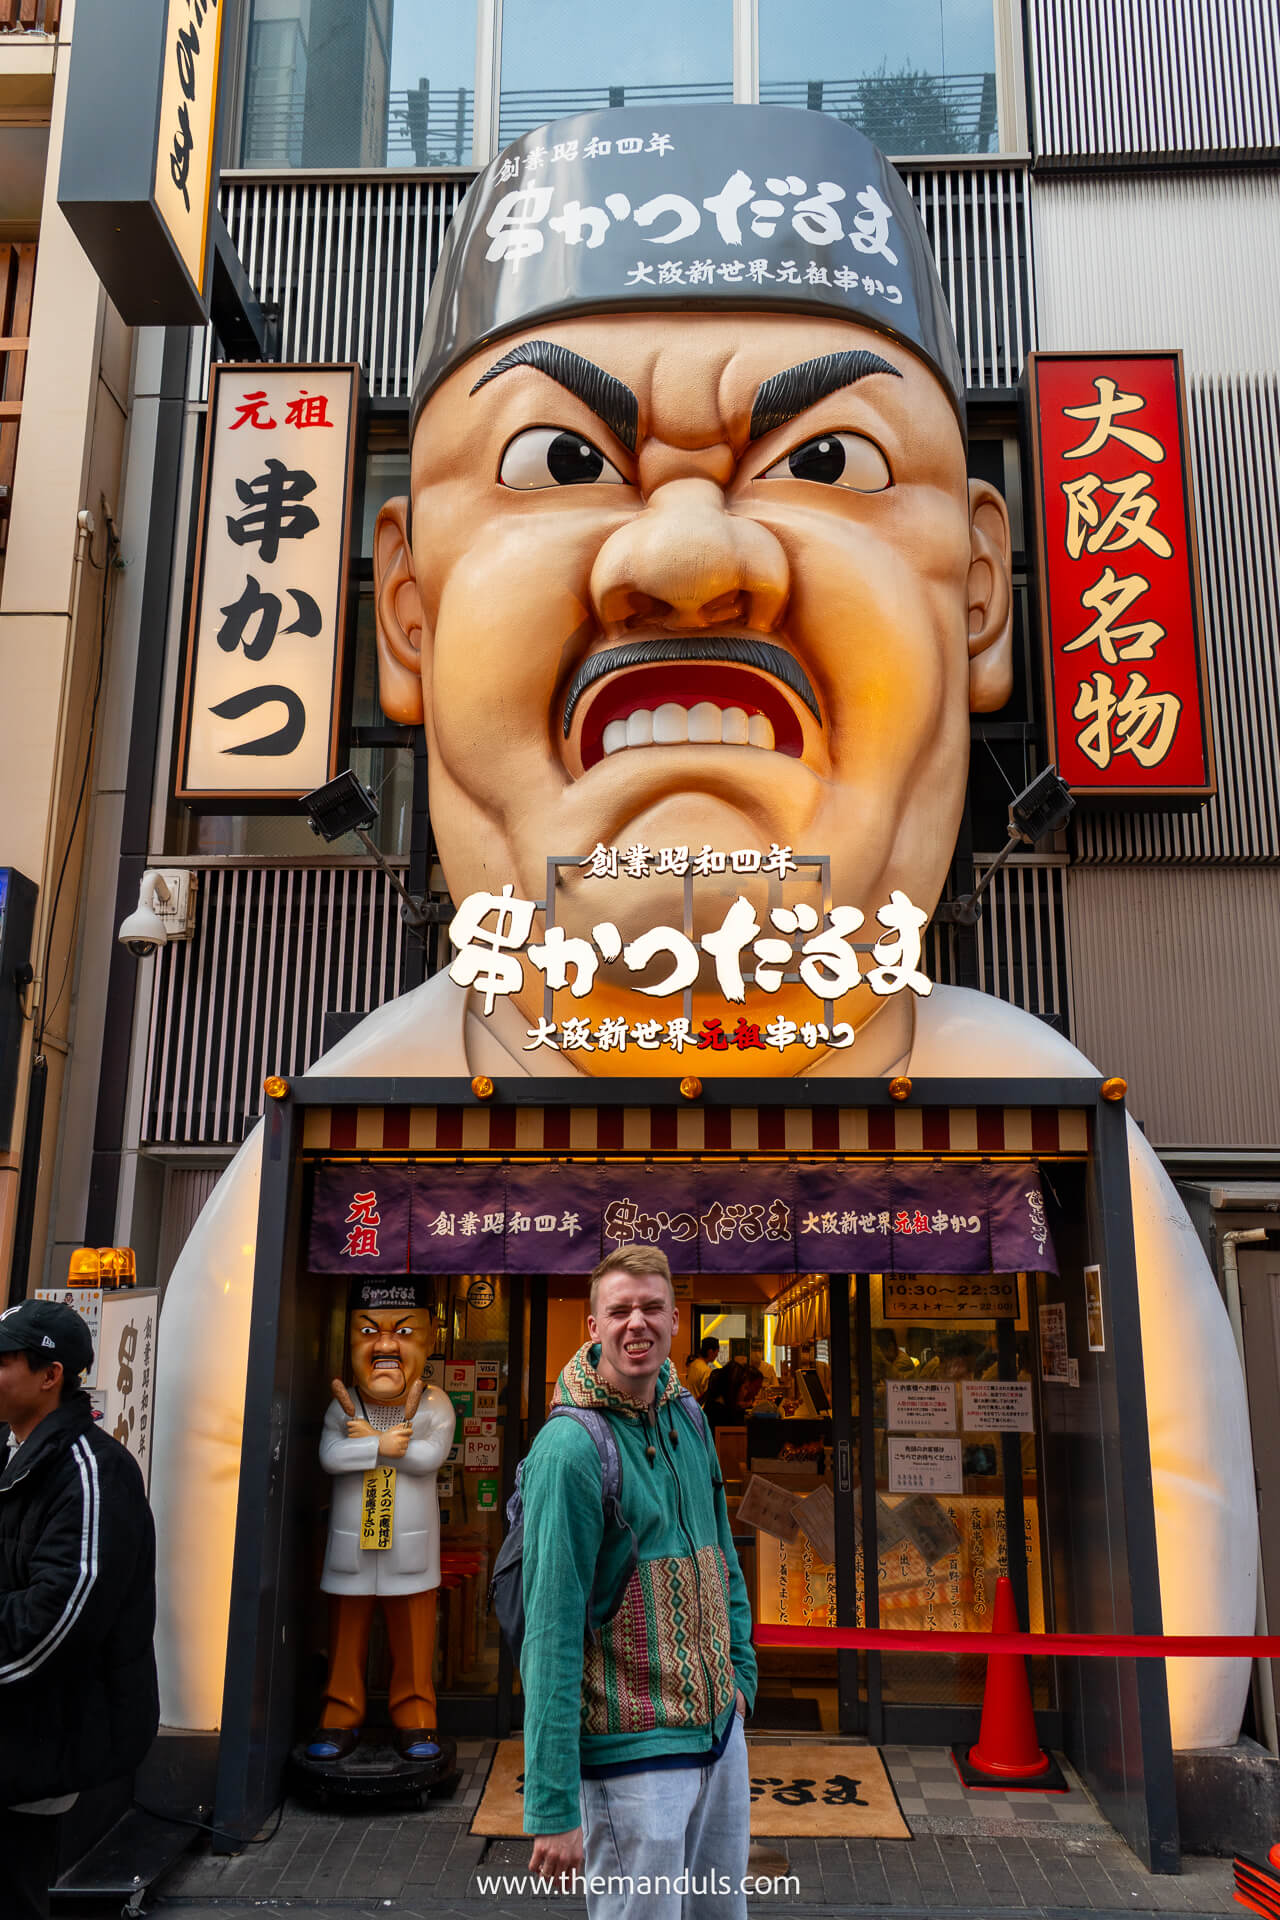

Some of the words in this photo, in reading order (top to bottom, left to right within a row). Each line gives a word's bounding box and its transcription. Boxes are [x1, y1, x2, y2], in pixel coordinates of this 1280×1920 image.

[494, 132, 675, 187] 創業昭和四年
[485, 169, 898, 275] 串かつだるま
[624, 258, 903, 305] 大阪新世界元祖串かつ
[228, 390, 335, 430] 元祖
[1062, 375, 1183, 770] 大阪名物
[208, 457, 323, 757] 串かつ
[579, 843, 798, 880] 創業昭和四年
[448, 884, 934, 1016] 串かつだるま
[339, 1190, 381, 1257] 元祖
[427, 1210, 583, 1238] 創業昭和四年
[604, 1198, 791, 1248] 串かつだるま
